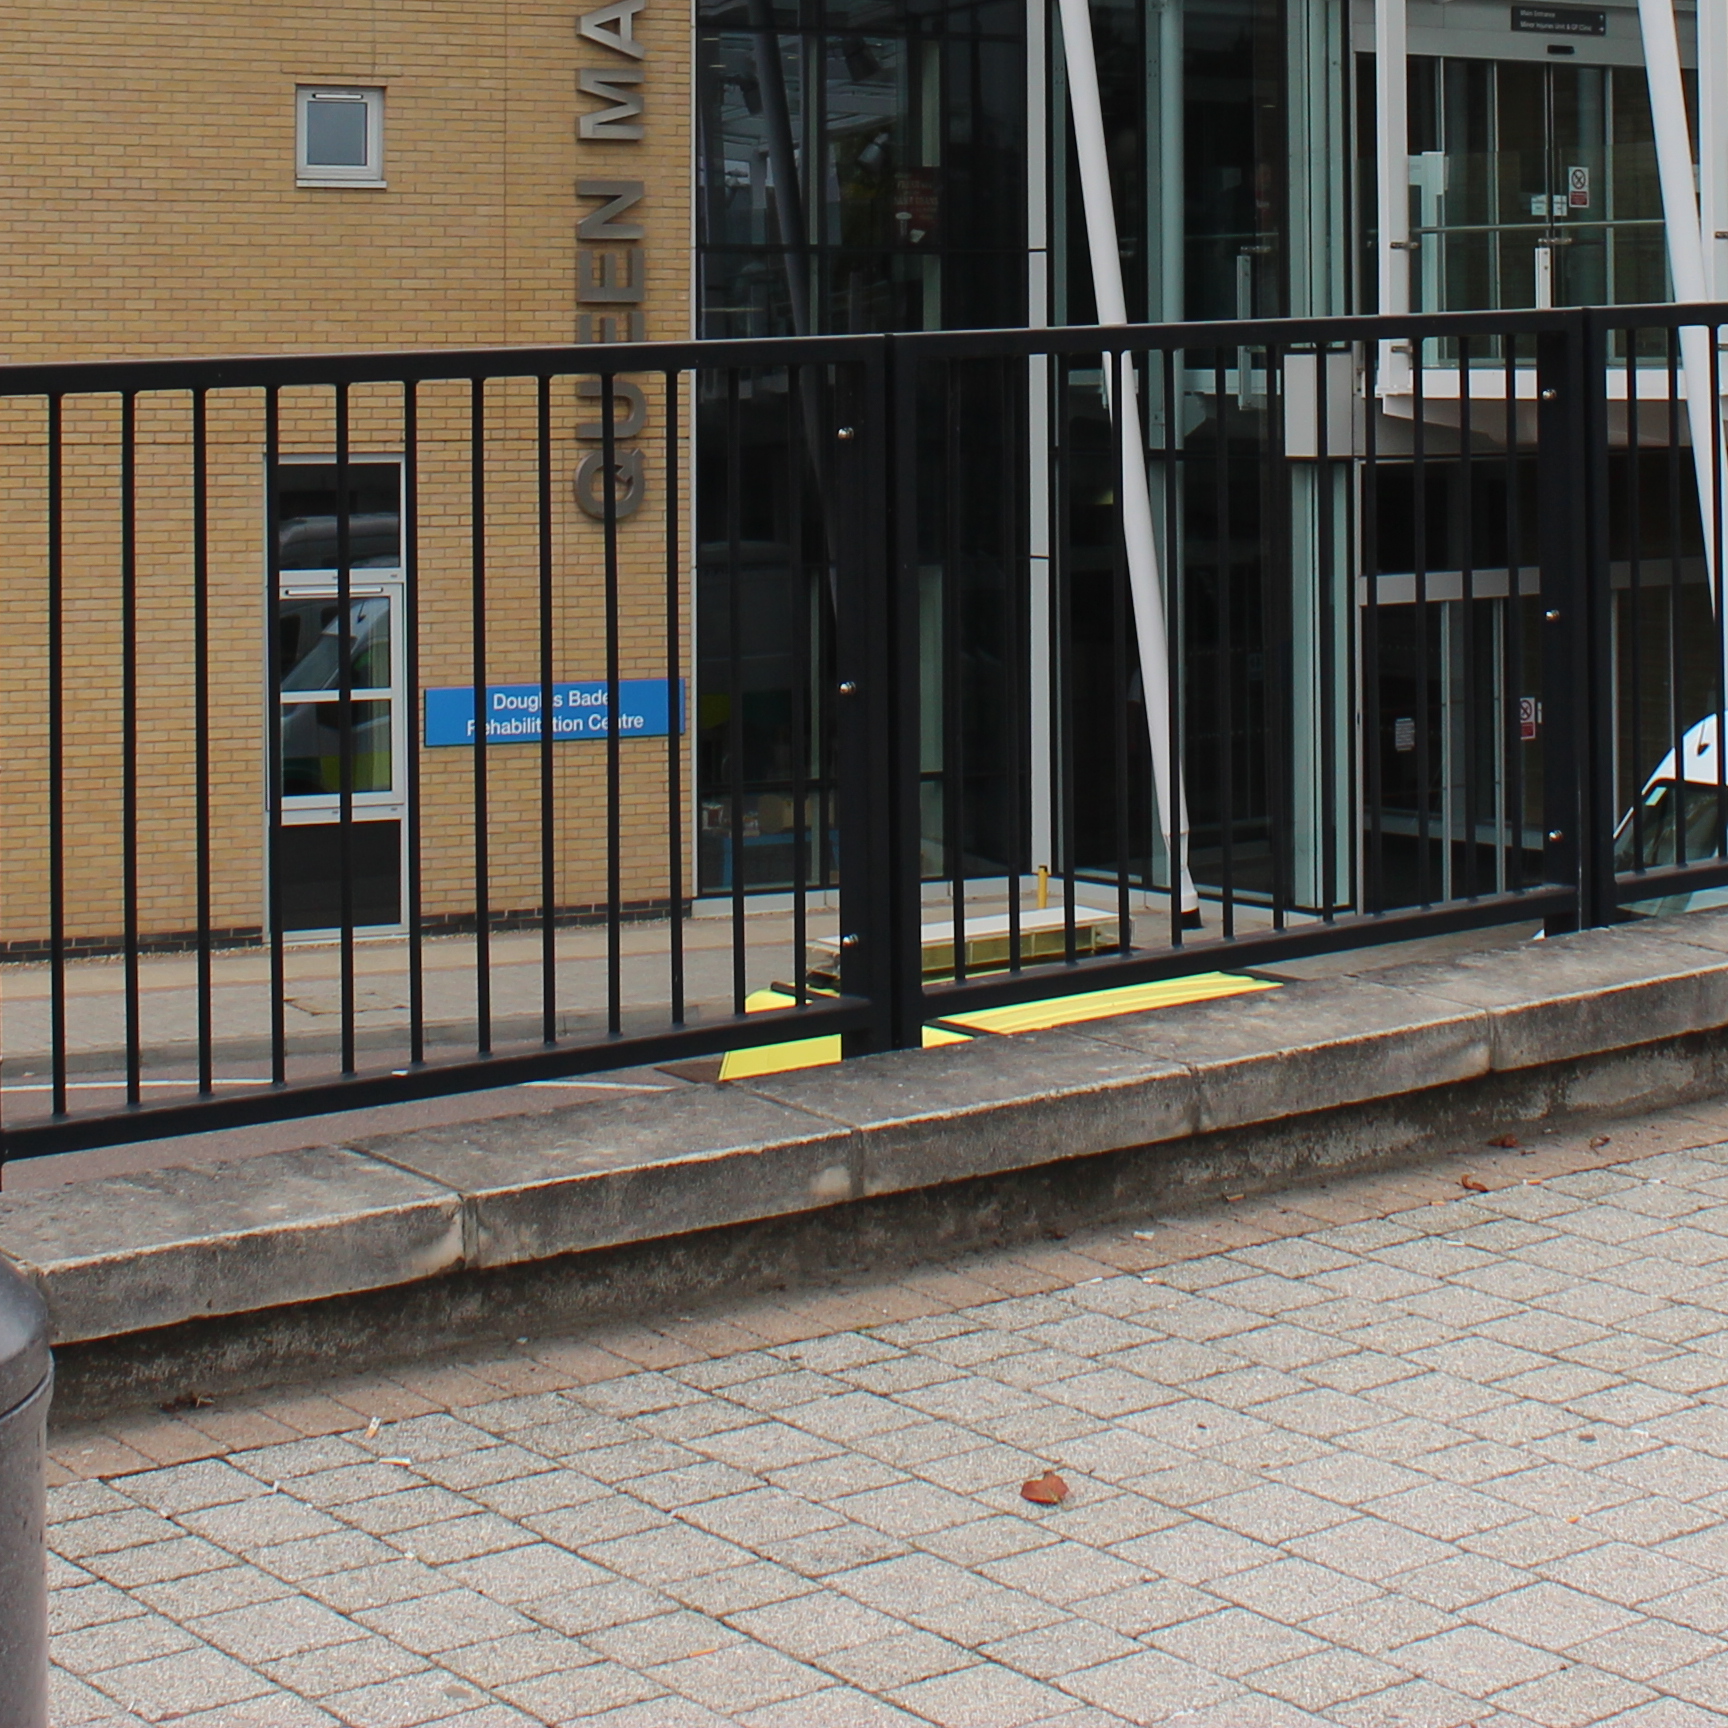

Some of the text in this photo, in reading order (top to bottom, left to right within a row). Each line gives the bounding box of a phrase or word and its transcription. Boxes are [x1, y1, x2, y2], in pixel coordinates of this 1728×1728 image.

[574, 180, 646, 521] QUEEN
[493, 688, 609, 713] Dougls Bade
[588, 713, 644, 731] Cetre
